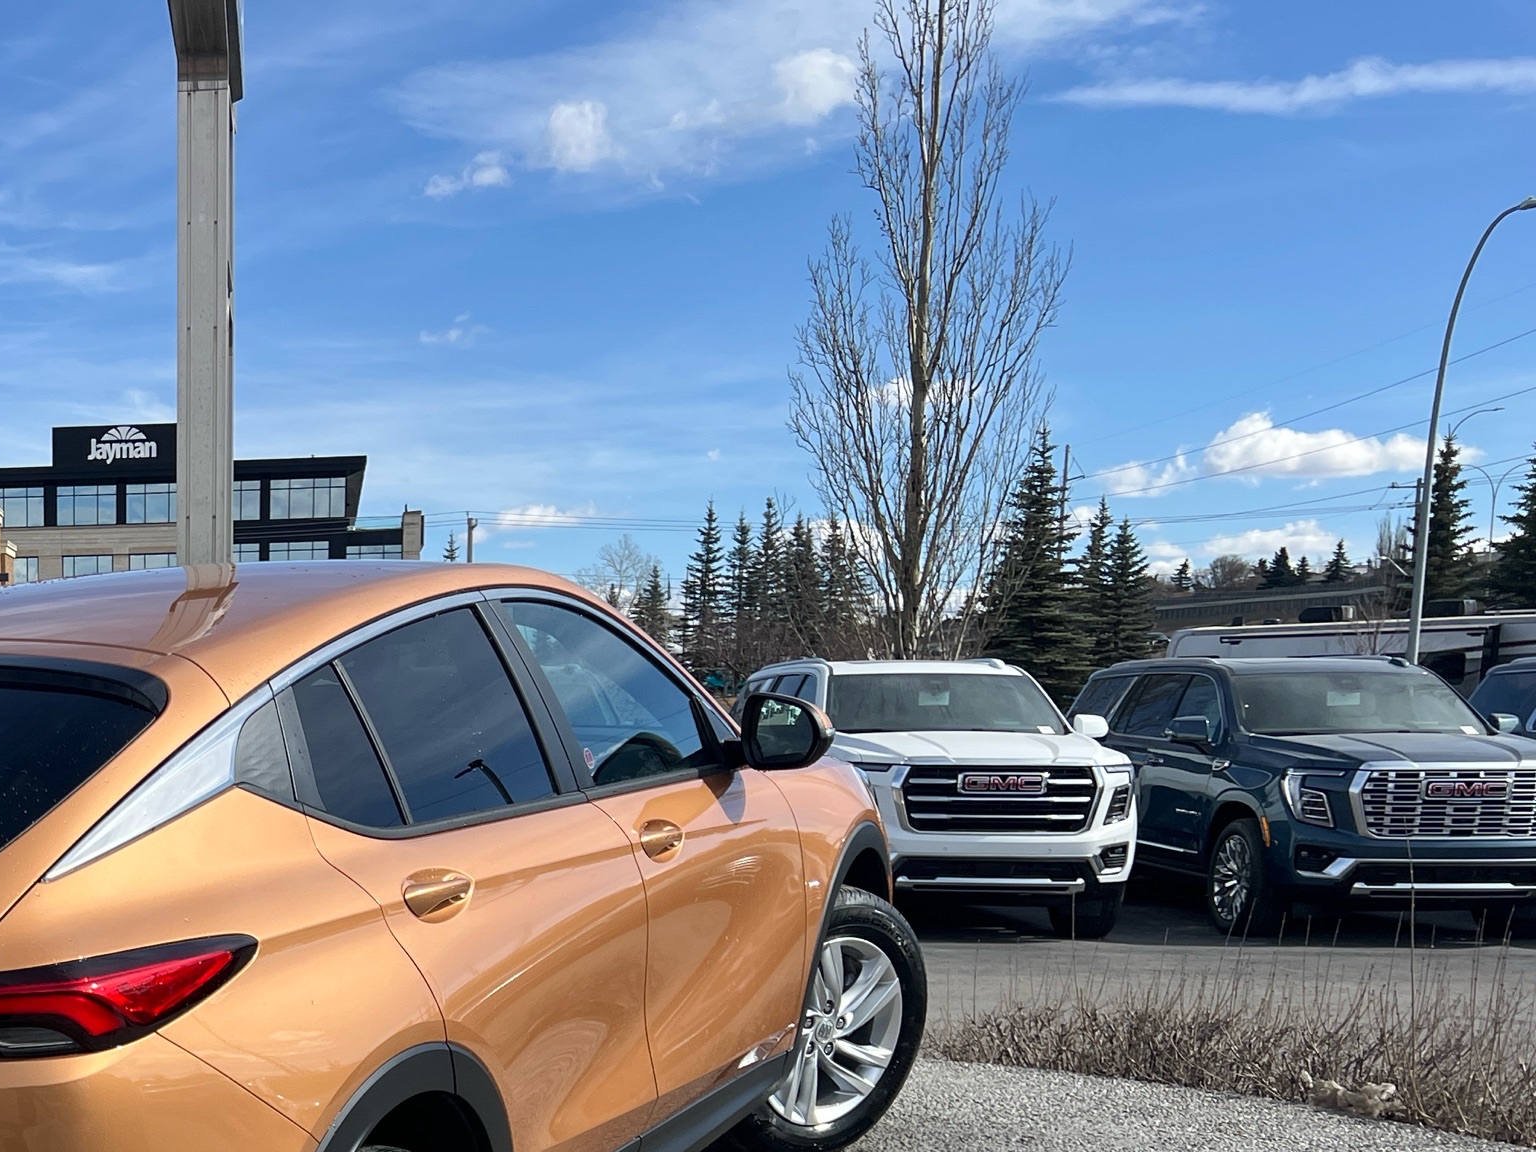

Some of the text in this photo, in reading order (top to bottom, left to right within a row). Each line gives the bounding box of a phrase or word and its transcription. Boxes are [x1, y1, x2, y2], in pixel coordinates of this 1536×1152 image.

[87, 438, 157, 465] Jayman
[964, 775, 1042, 791] GMC
[1427, 782, 1508, 797] GMC
